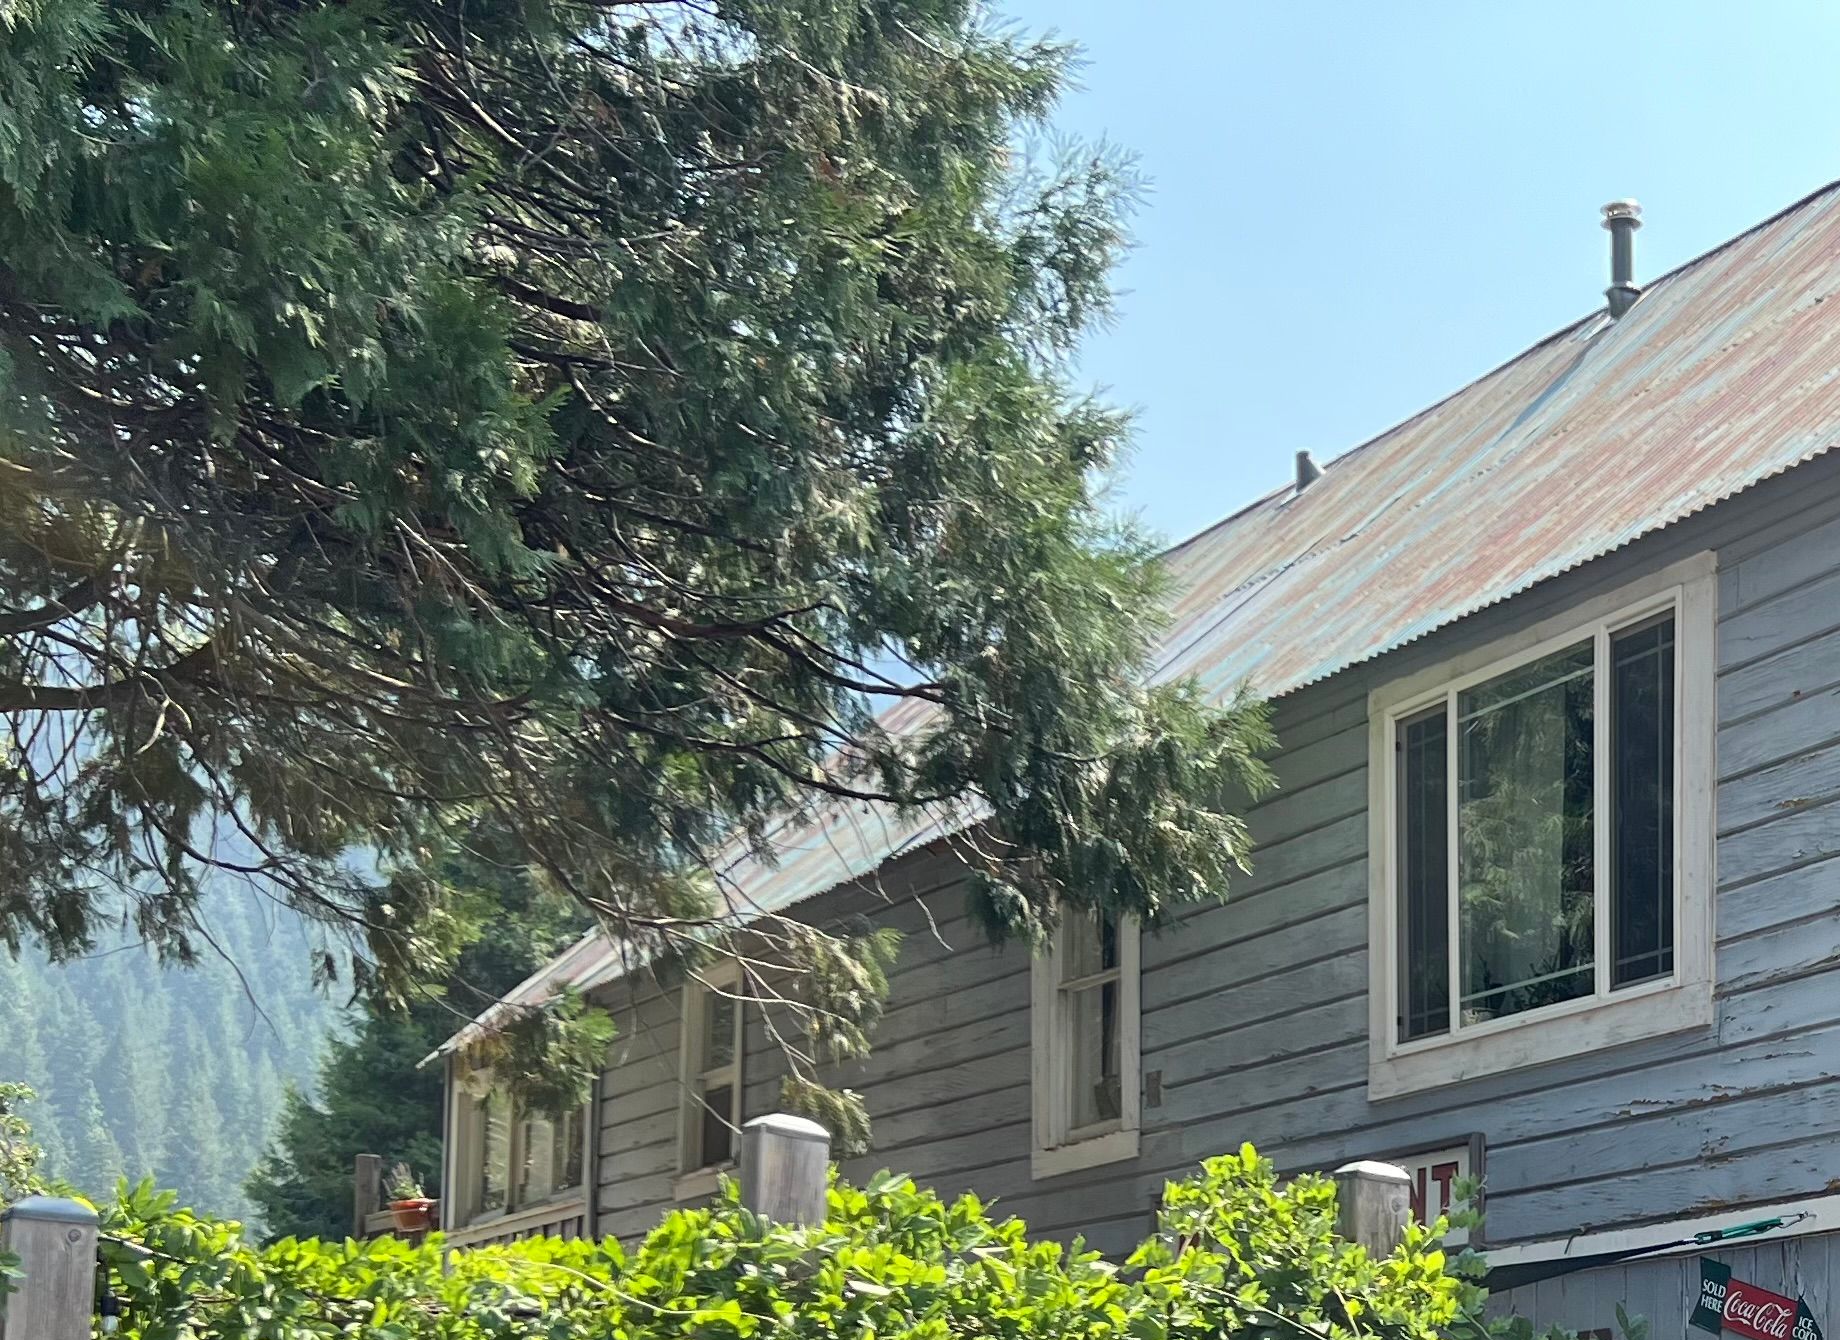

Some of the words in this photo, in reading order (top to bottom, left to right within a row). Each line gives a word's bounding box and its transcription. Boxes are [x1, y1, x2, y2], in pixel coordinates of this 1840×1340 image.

[1703, 1279, 1727, 1298] SOLD
[1700, 1294, 1722, 1313] HERE
[1723, 1291, 1793, 1339] Coca-Cola
[1799, 1316, 1814, 1329] ICE
